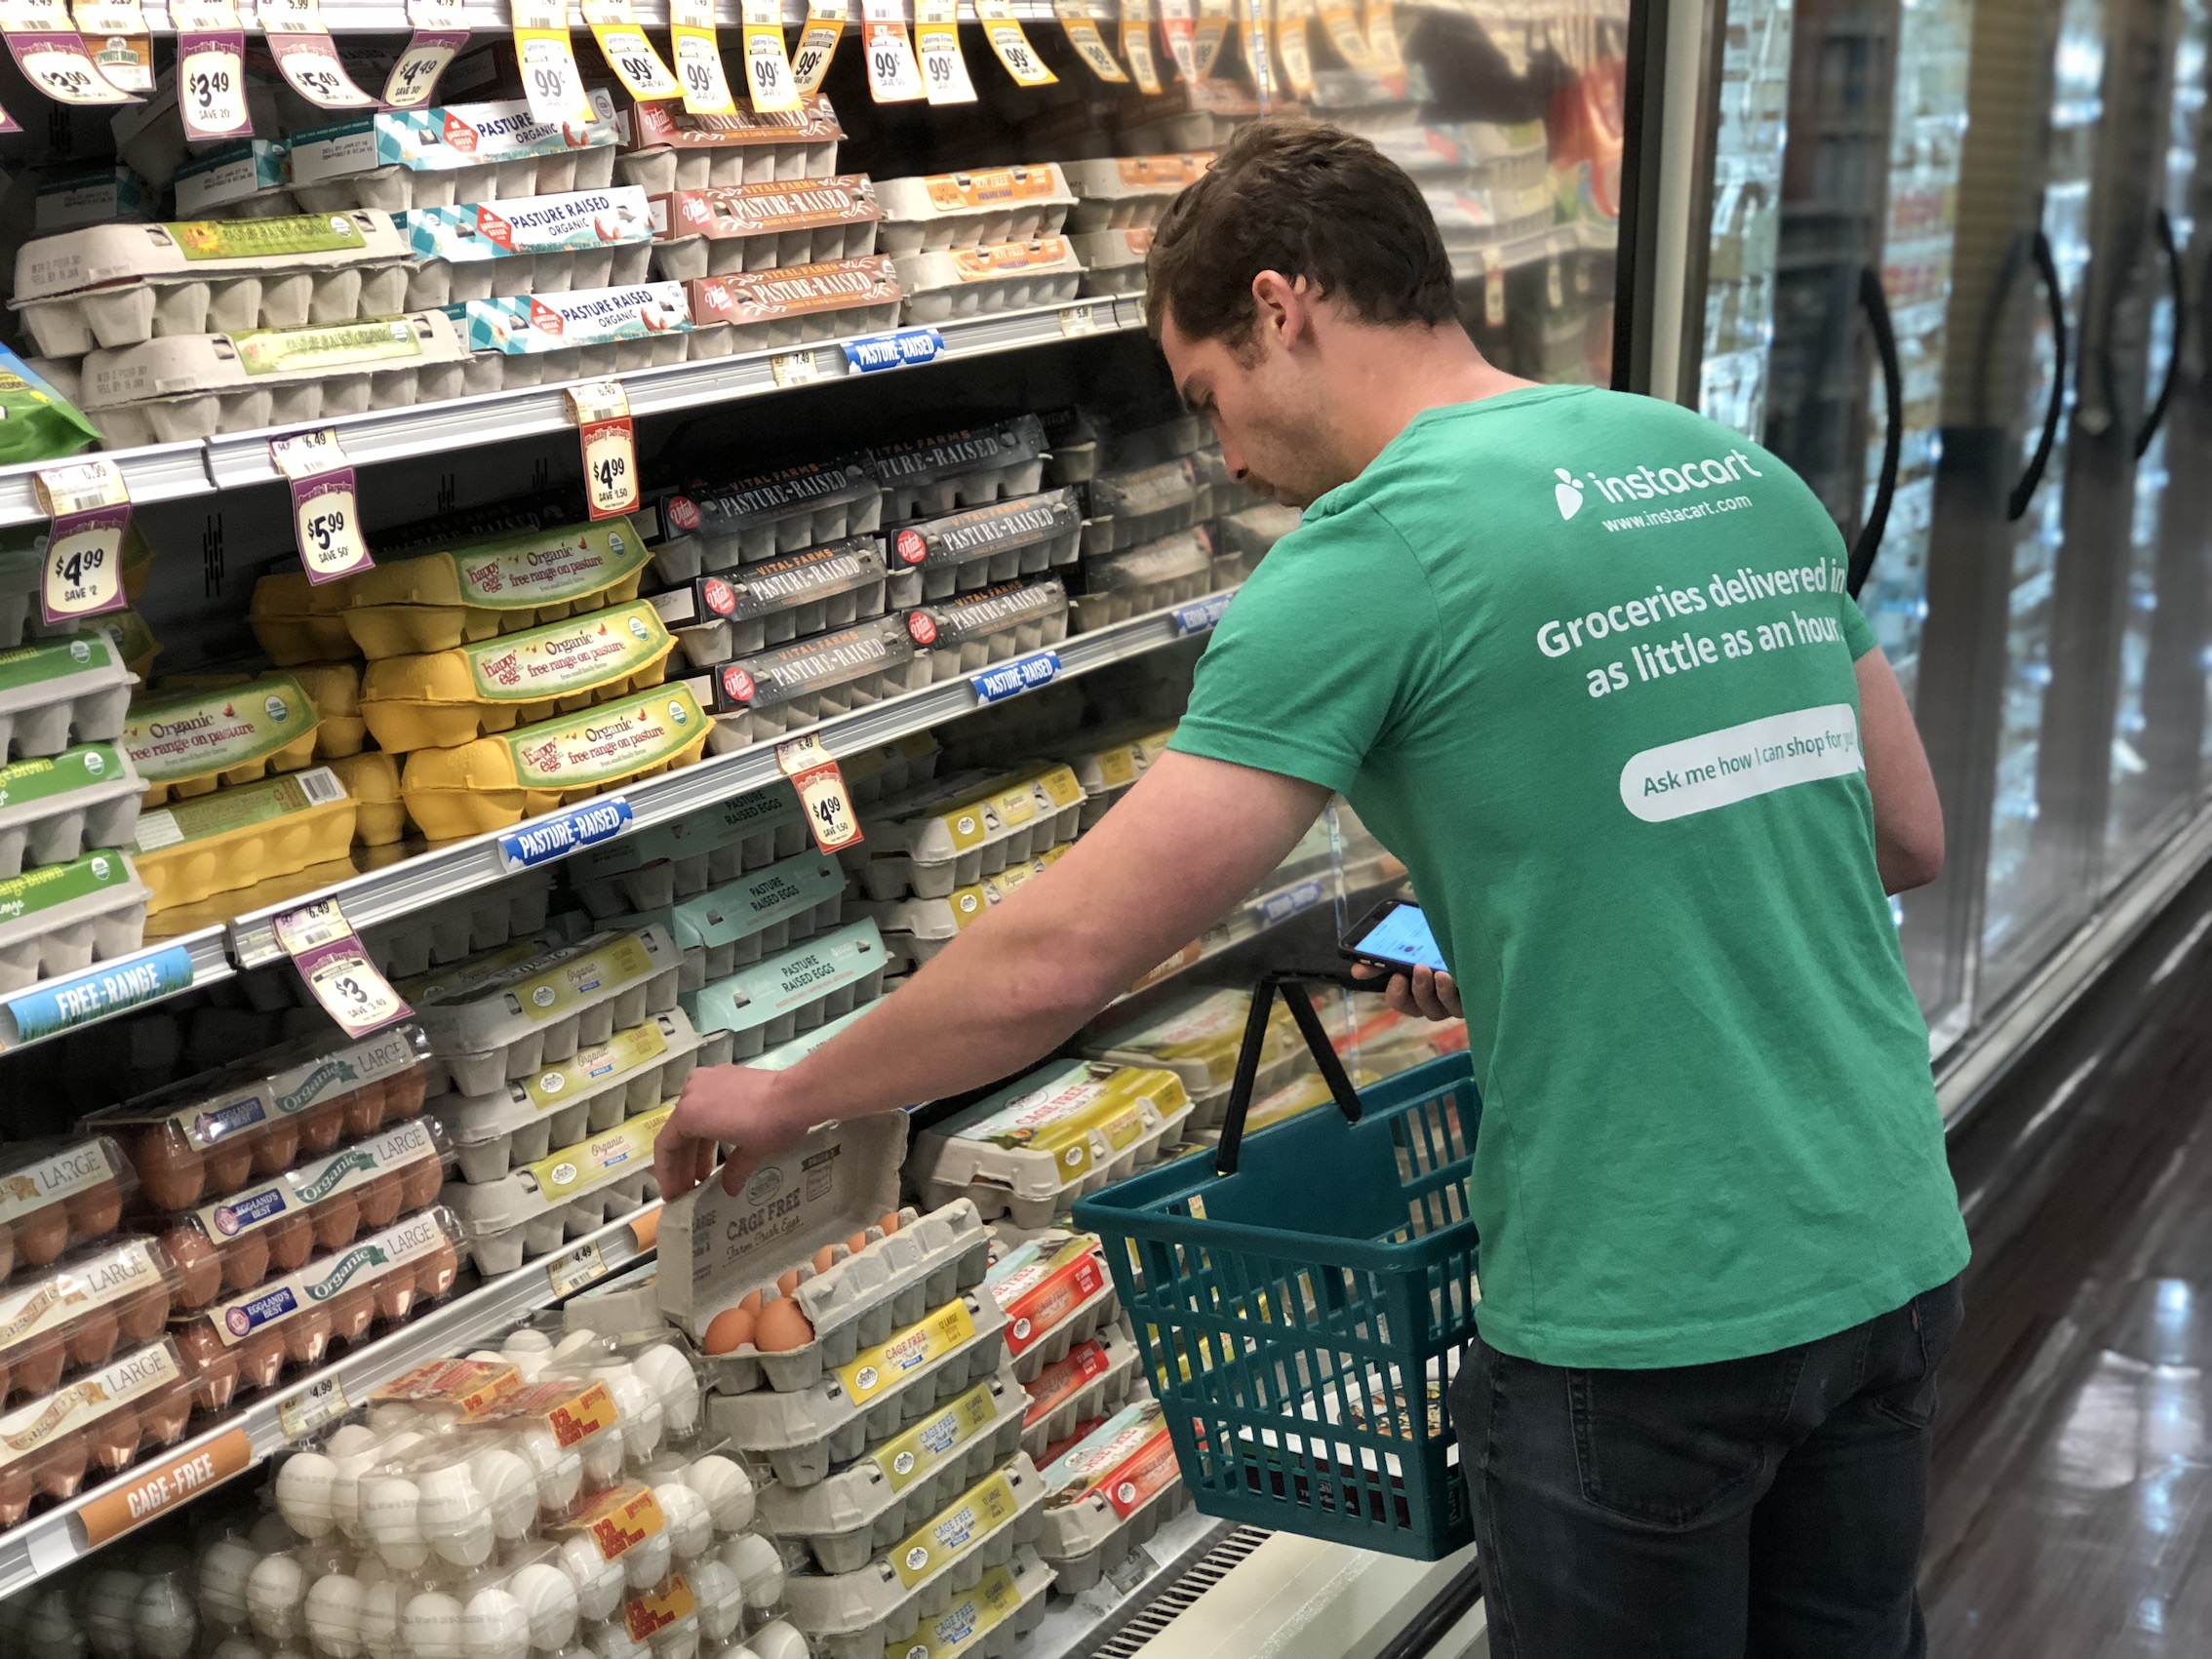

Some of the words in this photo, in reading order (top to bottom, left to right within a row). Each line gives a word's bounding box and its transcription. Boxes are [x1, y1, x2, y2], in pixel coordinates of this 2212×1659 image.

[395, 86, 410, 96] SAVE
[199, 110, 217, 120] SAVE
[477, 112, 535, 138] PASTURE
[516, 123, 558, 144] ORGANIC
[743, 182, 776, 194] VITAL
[779, 179, 817, 191] FARMS
[975, 178, 992, 189] SOY
[992, 176, 1009, 187] FREE
[509, 207, 564, 230] PASTURE
[568, 196, 610, 219] RAISED
[730, 188, 850, 218] PASTURE-RAISED
[548, 217, 590, 237] ORGANIC
[1008, 246, 1025, 257] FREE
[764, 268, 797, 280] VITAL
[800, 263, 839, 275] FARMS
[752, 271, 872, 304] PASTURE-RAISED
[561, 299, 612, 322] PASTURE
[614, 291, 652, 311] RAISED
[598, 309, 638, 328] ORGANIC
[855, 335, 934, 366] PASTURE-RAISED
[773, 462, 819, 482] FARMS
[1587, 449, 1763, 504] instacart
[599, 491, 613, 502] SAVE
[719, 470, 848, 517] PASTURE-RAISED
[669, 501, 693, 524] Vital
[951, 513, 984, 527] VITAL
[986, 500, 1030, 518] FARMS
[1601, 494, 1754, 533] www.instacart.com
[942, 507, 1054, 551] PASTURE-RAISED
[318, 551, 336, 564] SAVE
[527, 541, 573, 567] Organic
[898, 533, 922, 557] Vital
[466, 558, 500, 585] happy
[509, 570, 531, 587] free
[531, 566, 557, 584] range
[558, 565, 570, 575] on
[571, 554, 604, 576] pasture
[757, 559, 792, 576] VITAL
[793, 548, 834, 566] FARMS
[482, 576, 503, 593] egg
[750, 553, 860, 601] PASTURE-RAISED
[64, 588, 87, 602] SAVE
[706, 586, 730, 609] Vital
[955, 591, 987, 606] VITAL
[988, 580, 1023, 598] FARMS
[1536, 585, 1708, 658] Groceries
[1709, 556, 1827, 608] delivered
[1830, 558, 1846, 594] in
[950, 585, 1047, 631] PASTURE-RAISED
[910, 615, 931, 636] Vital
[545, 630, 594, 656] Organic
[778, 645, 816, 661] VITAL
[818, 631, 859, 651] FARMS
[482, 650, 518, 680] happy
[527, 663, 549, 679] free
[550, 655, 577, 674] range
[578, 652, 590, 663] on
[592, 639, 626, 662] pasture
[770, 637, 887, 687] PASTURE-RAISED
[1586, 659, 1630, 698] as
[1631, 632, 1719, 682] little
[1720, 628, 1754, 658] as
[1756, 620, 1795, 652] an
[498, 669, 521, 685] egg
[725, 673, 749, 696] Vital
[982, 657, 1053, 697] PASTURE-RAISED
[149, 710, 216, 739] Organic
[150, 737, 190, 757] range
[191, 733, 208, 746] on
[210, 720, 256, 746] pasture
[585, 715, 634, 743] Organic
[521, 736, 559, 768] happy
[568, 750, 589, 765] free
[590, 741, 617, 760] range
[618, 737, 632, 750] on
[633, 725, 665, 748] pasture
[539, 756, 562, 773] egg
[1643, 770, 1682, 797] Ask
[1684, 764, 1717, 786] me
[1718, 750, 1753, 776] how
[1754, 747, 1761, 767] I
[1761, 743, 1785, 765] can
[1787, 733, 1826, 758] shop
[1825, 730, 1842, 749] for
[725, 789, 767, 811] PASTURE
[725, 804, 757, 826] RAISED
[757, 798, 783, 815] EGGS
[518, 805, 620, 859] PASTURE-RAISED
[823, 826, 835, 838] SAVE
[748, 876, 784, 897] PASTURE
[750, 890, 779, 913] RAISED
[779, 884, 801, 902] EGGS
[567, 962, 597, 982] Organic
[781, 954, 819, 977] PASTURE
[781, 969, 814, 994] RAISED
[814, 963, 836, 981] EGGS
[55, 962, 161, 1021] FREE-RANGE
[335, 977, 368, 1004] $3
[347, 1007, 368, 1018] SAVE
[357, 1042, 407, 1072] LARGE
[577, 1046, 609, 1067] Organic
[283, 1063, 337, 1111] Organic
[1015, 1104, 1059, 1126] CAGE
[376, 1128, 425, 1160] LARGE
[591, 1134, 625, 1158] Organic
[40, 1151, 100, 1190] LARGE
[303, 1155, 357, 1202] Organic
[251, 1205, 271, 1220] BEST
[727, 1207, 765, 1242] CAGE
[768, 1188, 801, 1222] FREE
[387, 1222, 435, 1256] LARGE
[87, 1255, 147, 1293] LARGE
[314, 1248, 370, 1298] Organic
[262, 1304, 283, 1320] BEST
[885, 1341, 908, 1361] CAGE
[908, 1328, 928, 1349] FREE
[106, 1350, 166, 1394] LARGE
[549, 1406, 573, 1430] 12
[919, 1423, 938, 1444] CAGE
[937, 1411, 956, 1432] FREE
[127, 1453, 216, 1520] CAGE-FREE
[592, 1518, 616, 1541] 12
[932, 1519, 955, 1539] CAGE
[955, 1506, 972, 1525] FREE
[933, 1615, 956, 1637] CAGE
[955, 1600, 974, 1622] FREE
